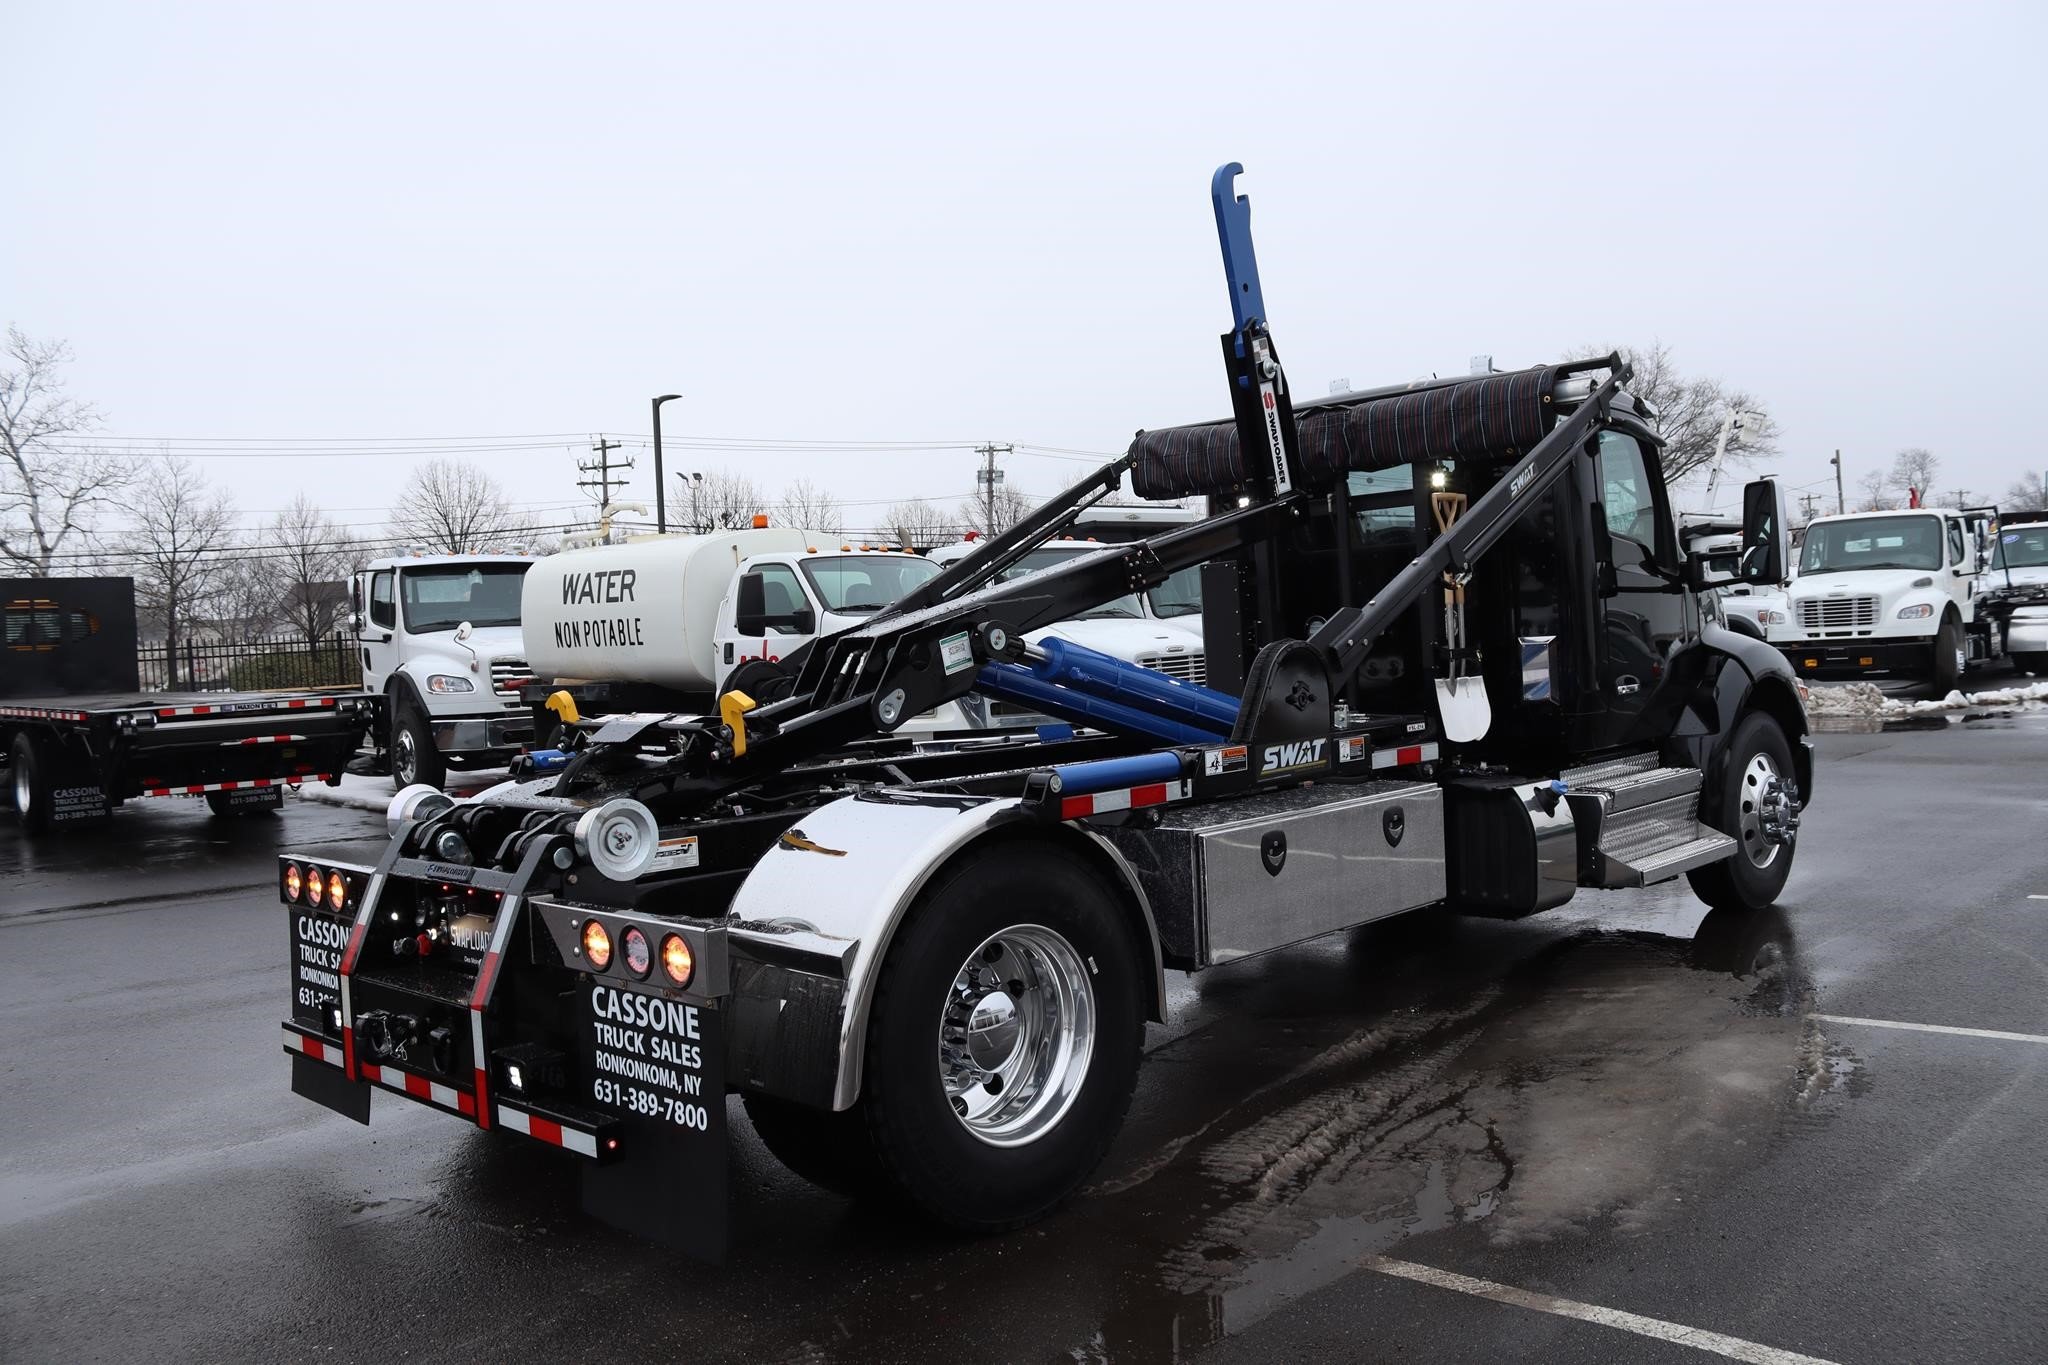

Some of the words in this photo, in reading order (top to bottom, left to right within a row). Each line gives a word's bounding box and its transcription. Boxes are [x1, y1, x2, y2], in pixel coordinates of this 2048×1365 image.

[1267, 411, 1287, 484] SWAPLOADER
[1510, 461, 1535, 497] SWAT
[563, 569, 636, 605] WATER
[555, 621, 581, 648] NON
[584, 618, 644, 647] POTABLE
[1262, 737, 1327, 771] SWAT
[298, 916, 352, 950] CASSON
[450, 925, 491, 952] SWAPLOAD
[299, 944, 329, 968] TRUCK
[300, 965, 339, 990] RONKONKOM
[592, 986, 701, 1041] CASSONE
[594, 1022, 646, 1056] TRUCK
[651, 1036, 702, 1069] SALES
[596, 1050, 682, 1095] RONKONKOMA,
[684, 1073, 702, 1097] NY
[594, 1078, 708, 1131] 631-389-7800
